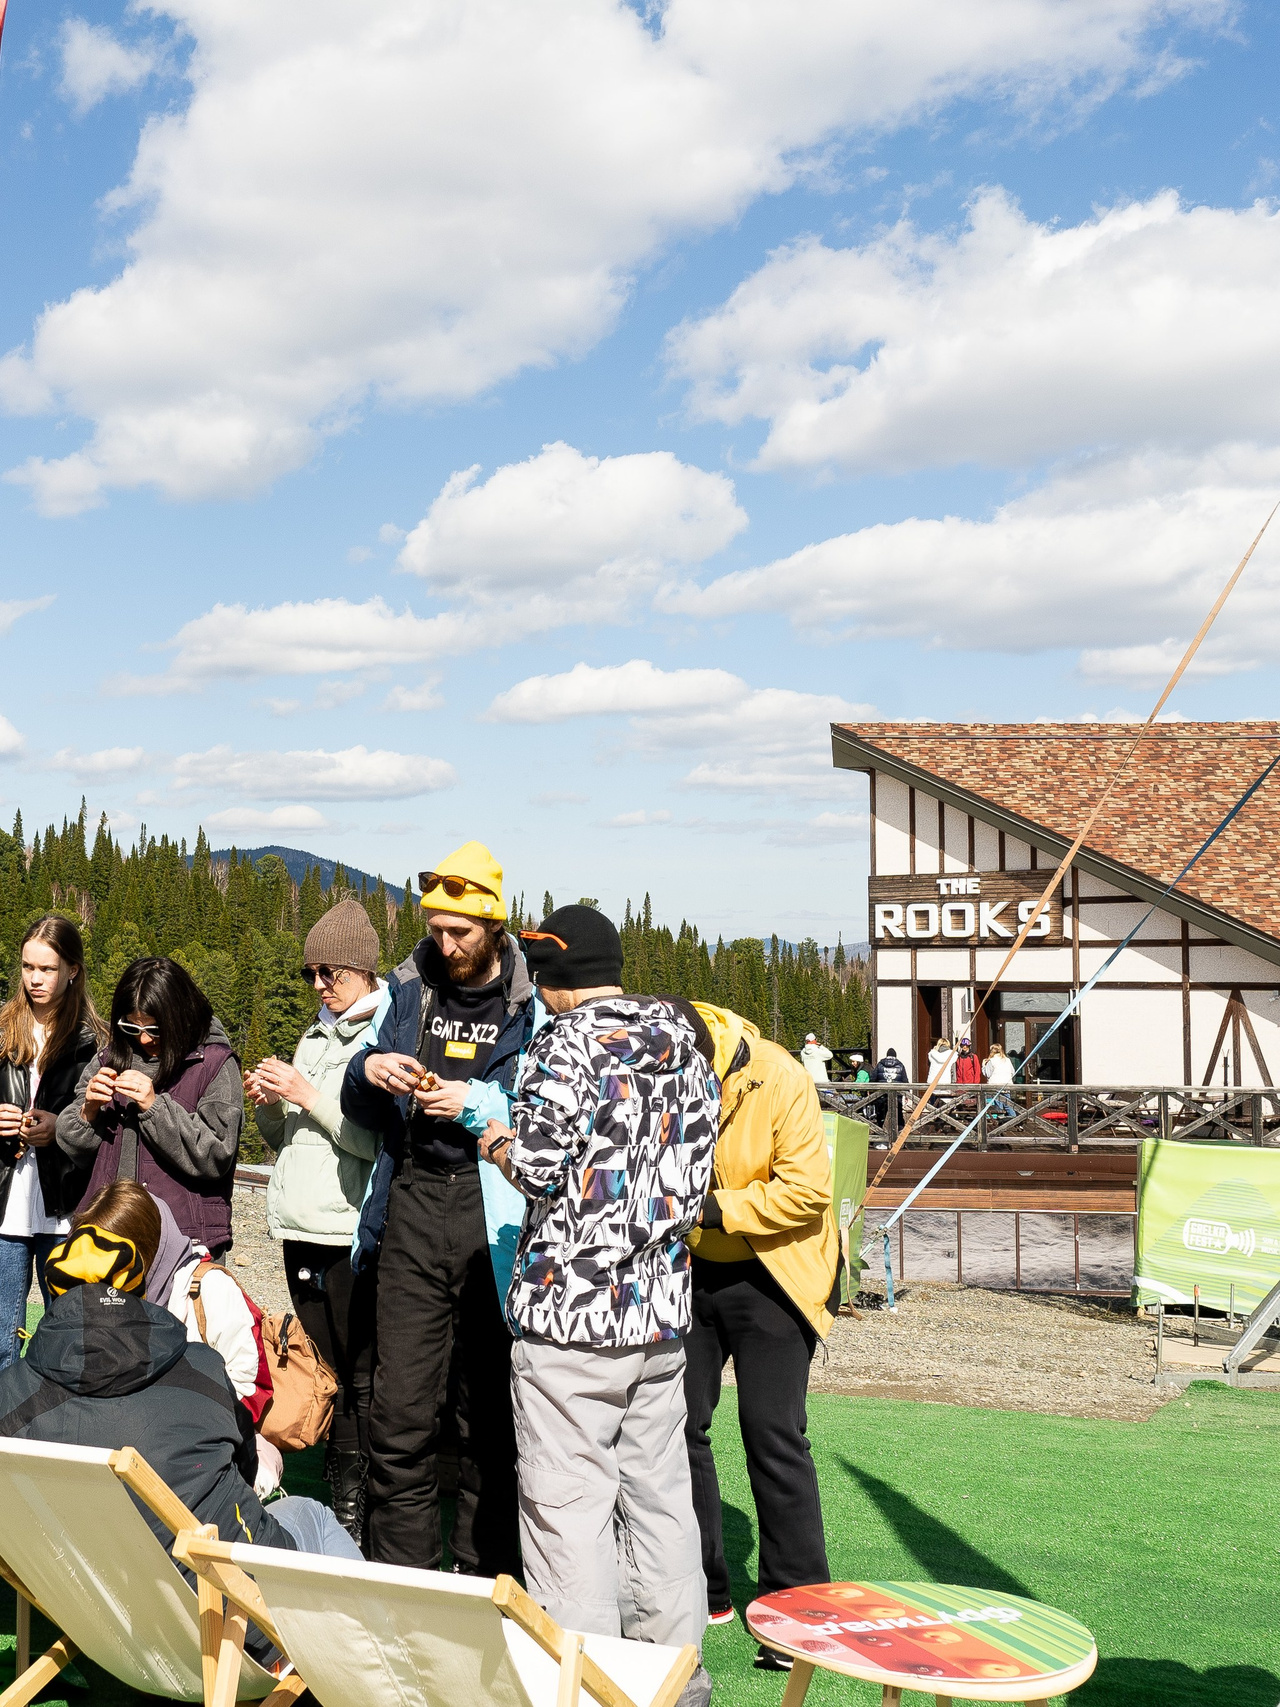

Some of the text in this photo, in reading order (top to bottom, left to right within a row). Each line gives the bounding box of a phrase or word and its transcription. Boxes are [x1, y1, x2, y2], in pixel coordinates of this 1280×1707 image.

[936, 877, 981, 895] THE
[874, 901, 1051, 938] ROOKS
[1189, 1234, 1214, 1247] FEST
